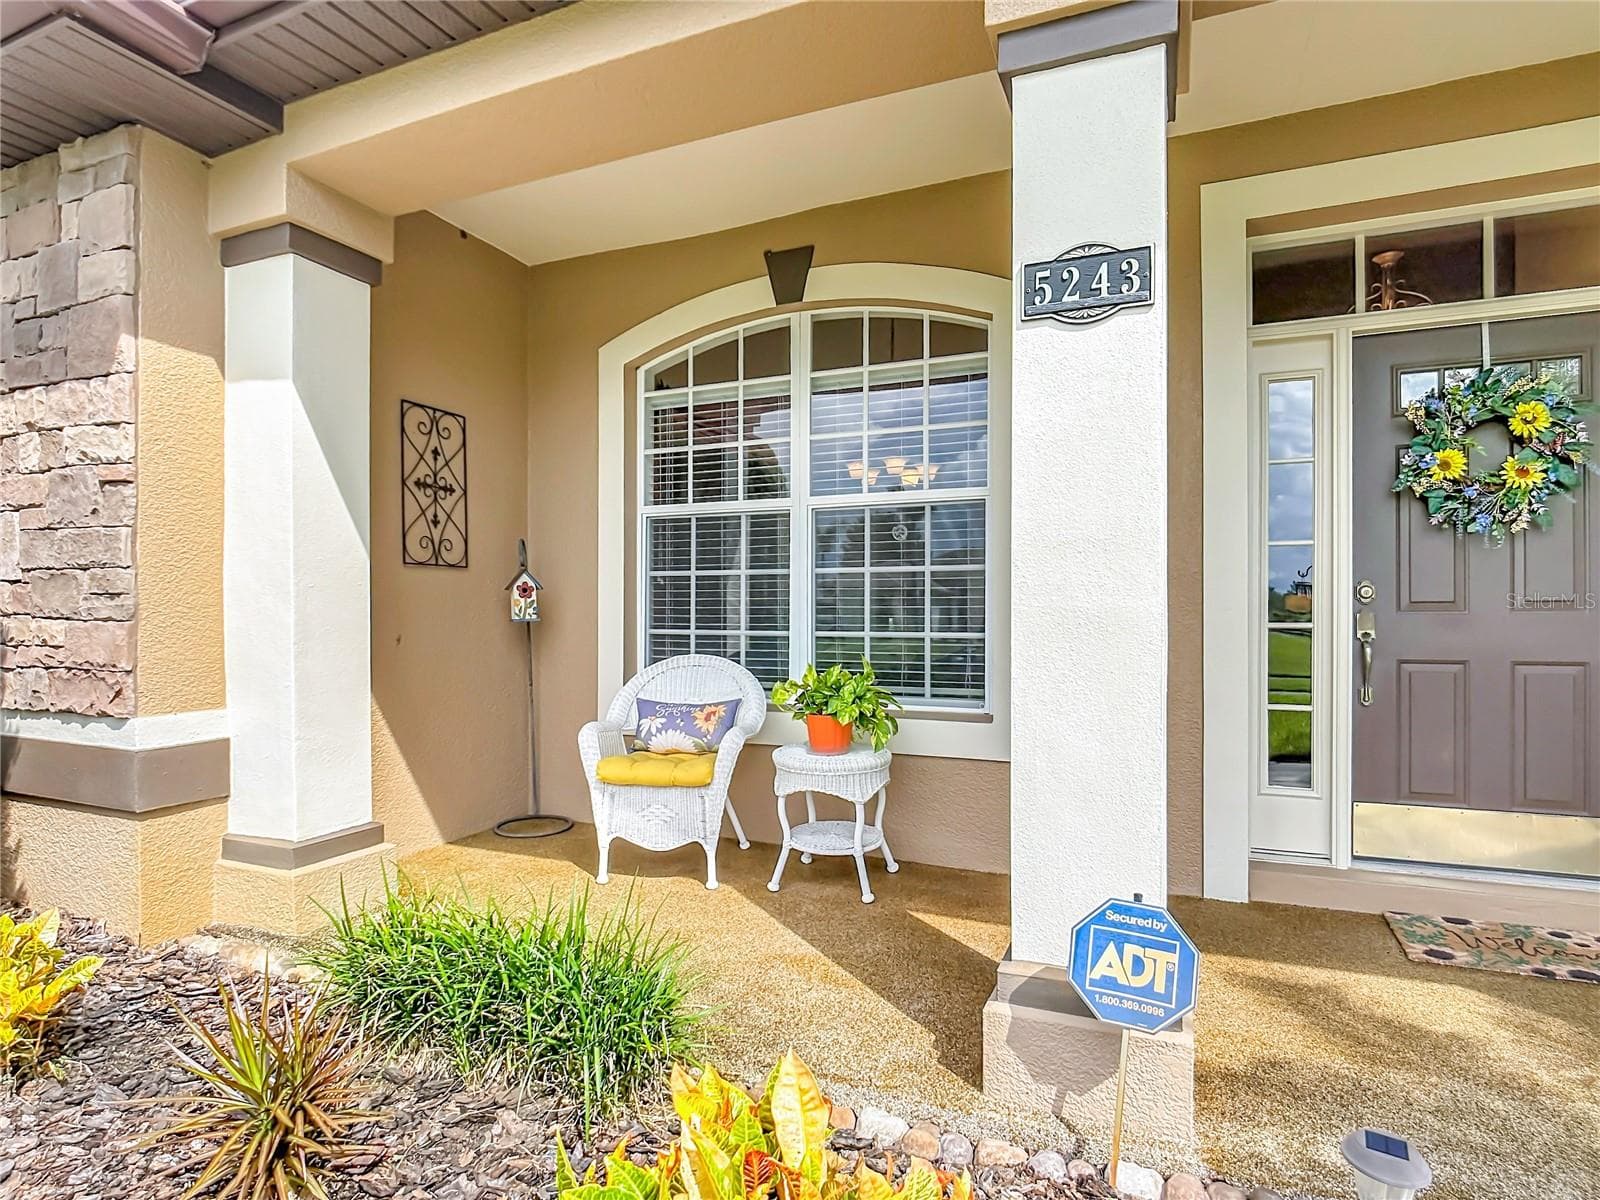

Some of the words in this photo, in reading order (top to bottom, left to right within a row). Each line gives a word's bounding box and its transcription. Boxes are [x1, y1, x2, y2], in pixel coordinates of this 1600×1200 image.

[1033, 258, 1141, 306] 5243
[655, 703, 701, 717] Sunshine
[1105, 909, 1152, 927] Secured
[1152, 918, 1168, 933] by
[1094, 994, 1165, 1017] 1.800.369.0996
